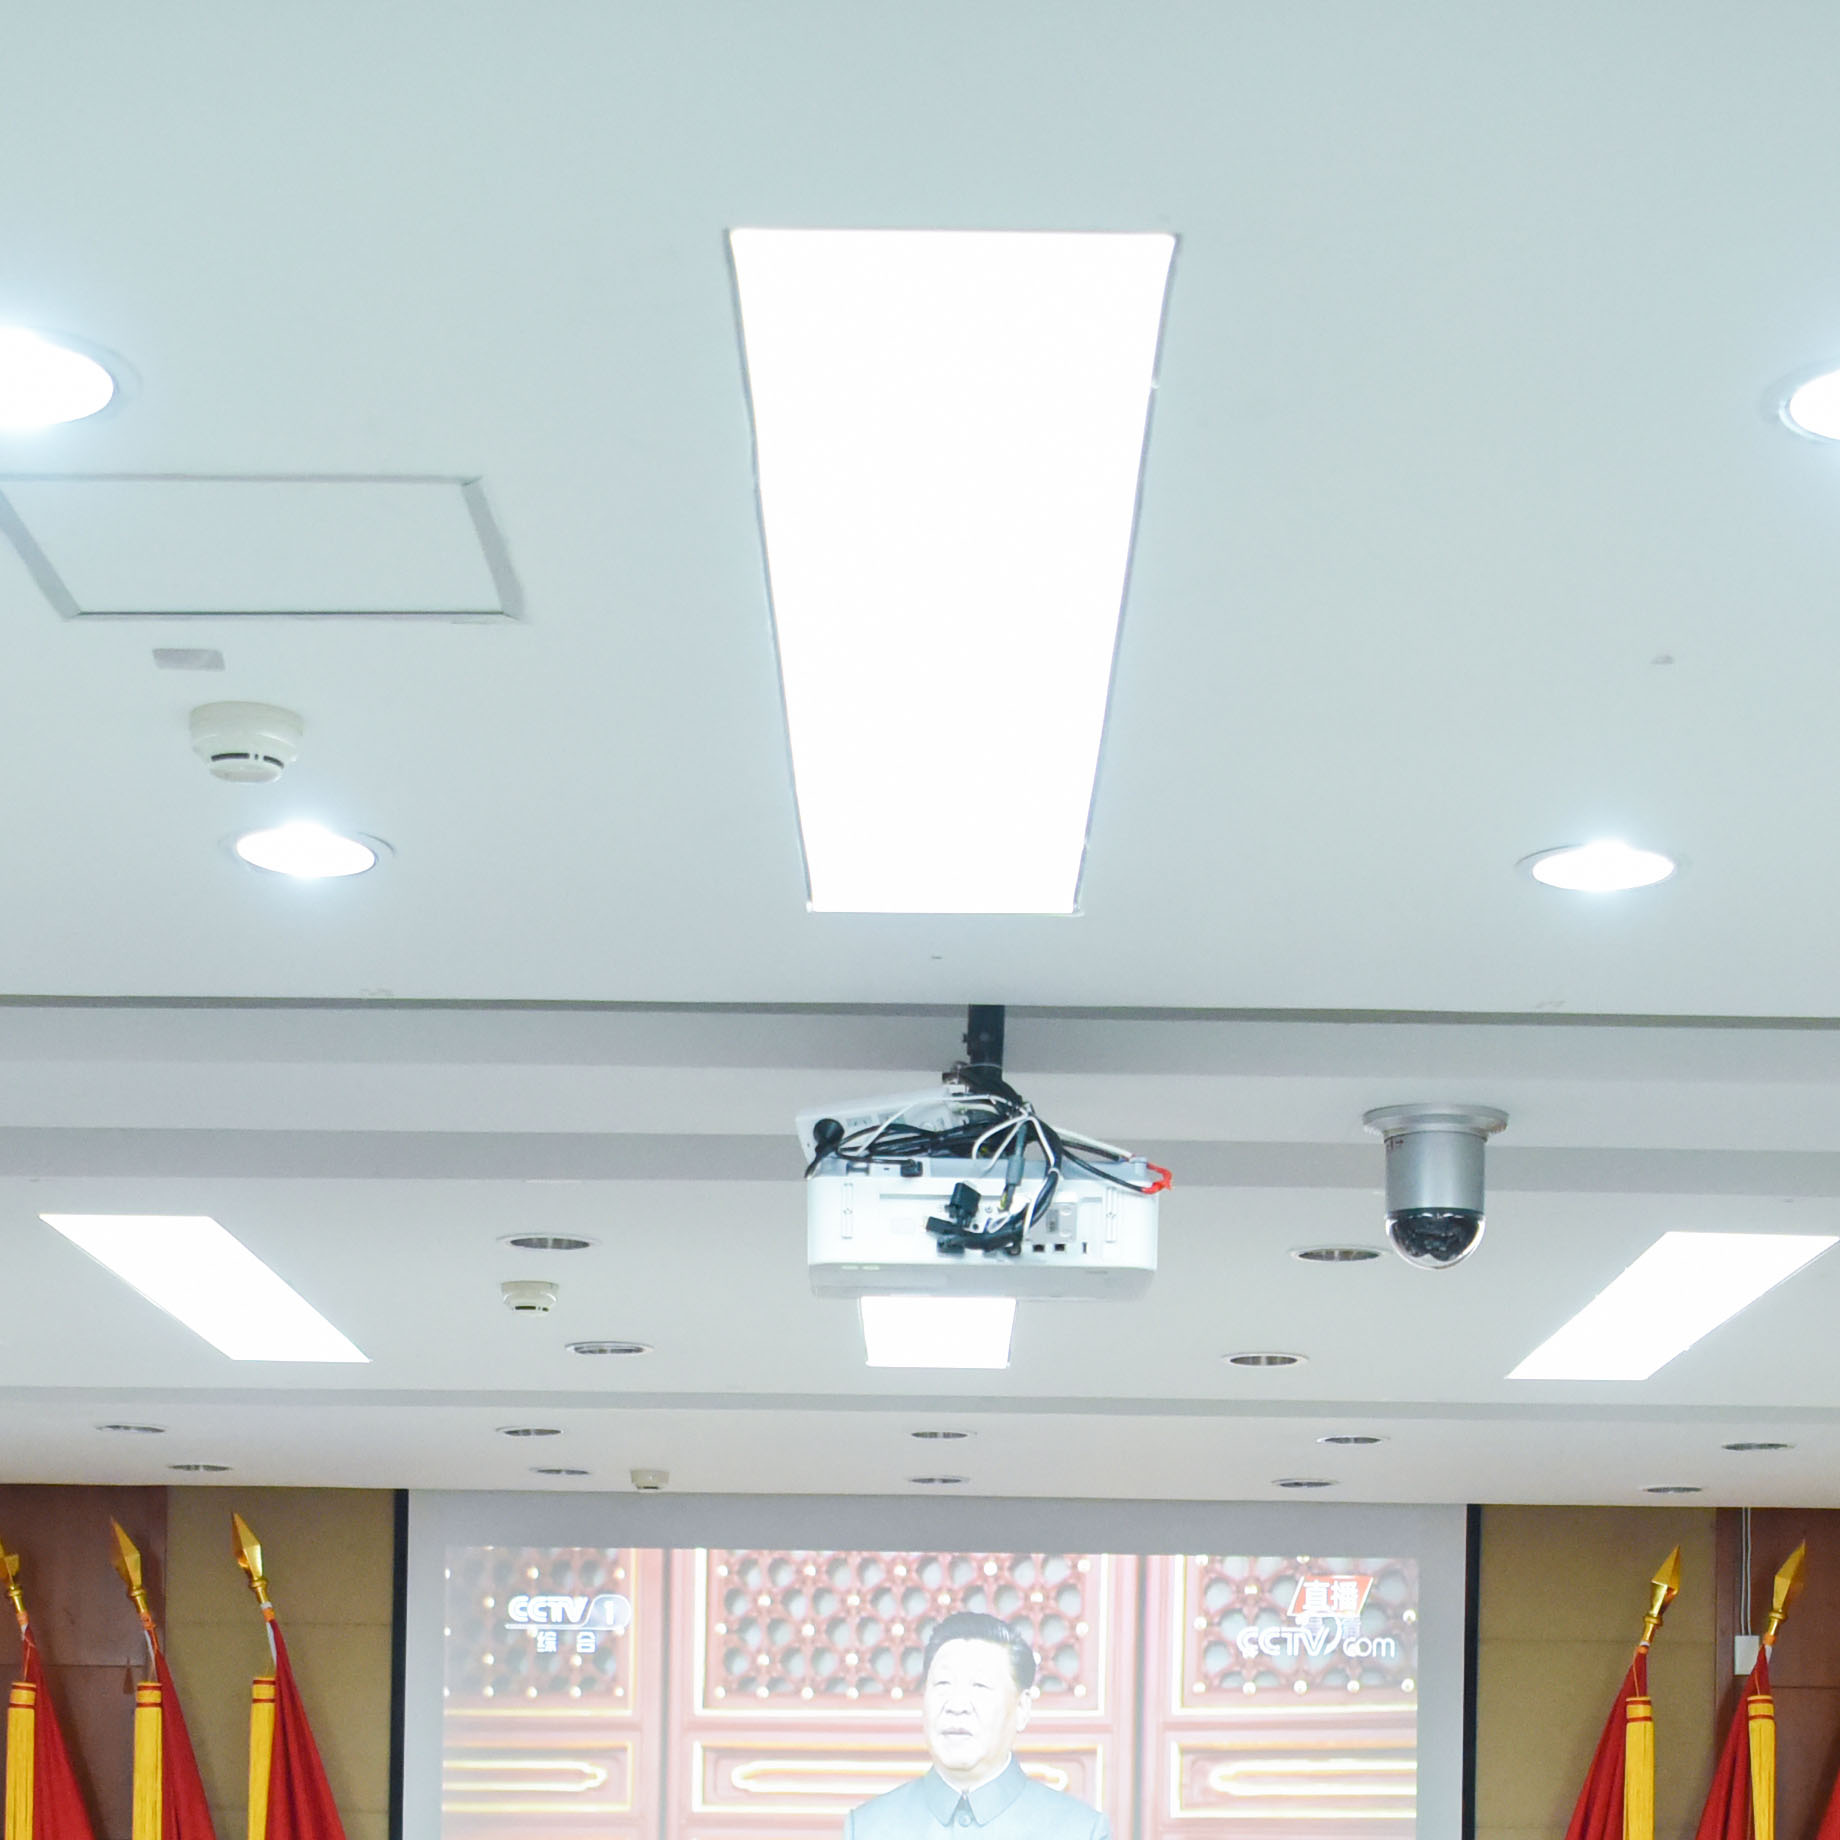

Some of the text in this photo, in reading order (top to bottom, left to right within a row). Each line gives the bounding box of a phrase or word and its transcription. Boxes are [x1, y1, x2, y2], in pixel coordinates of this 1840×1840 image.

[507, 1594, 589, 1623] CCTV
[1302, 1580, 1359, 1612] 直播
[536, 1631, 597, 1654] 综合
